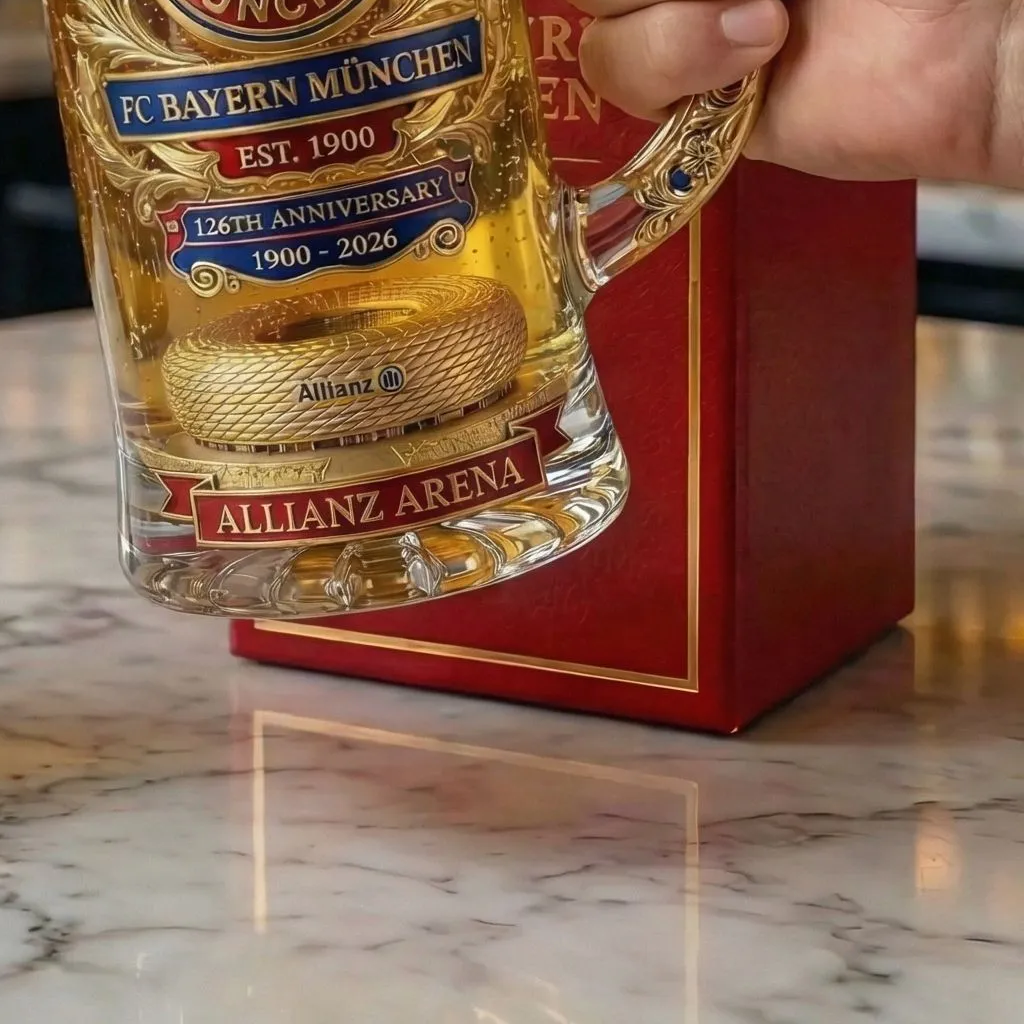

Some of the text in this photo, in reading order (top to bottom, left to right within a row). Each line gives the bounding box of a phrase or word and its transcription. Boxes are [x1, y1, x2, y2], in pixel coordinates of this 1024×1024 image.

[121, 95, 155, 125] FC
[161, 75, 298, 123] BAYERN
[308, 35, 473, 103] MÜNCHEN
[235, 125, 376, 170] EST. 1900
[193, 178, 444, 238] 126TH ANNIVERSARY
[251, 243, 312, 272] 1900
[336, 228, 399, 261] 2026
[298, 378, 374, 403] Allianz
[216, 456, 526, 536] ALLIANZ ARENA
